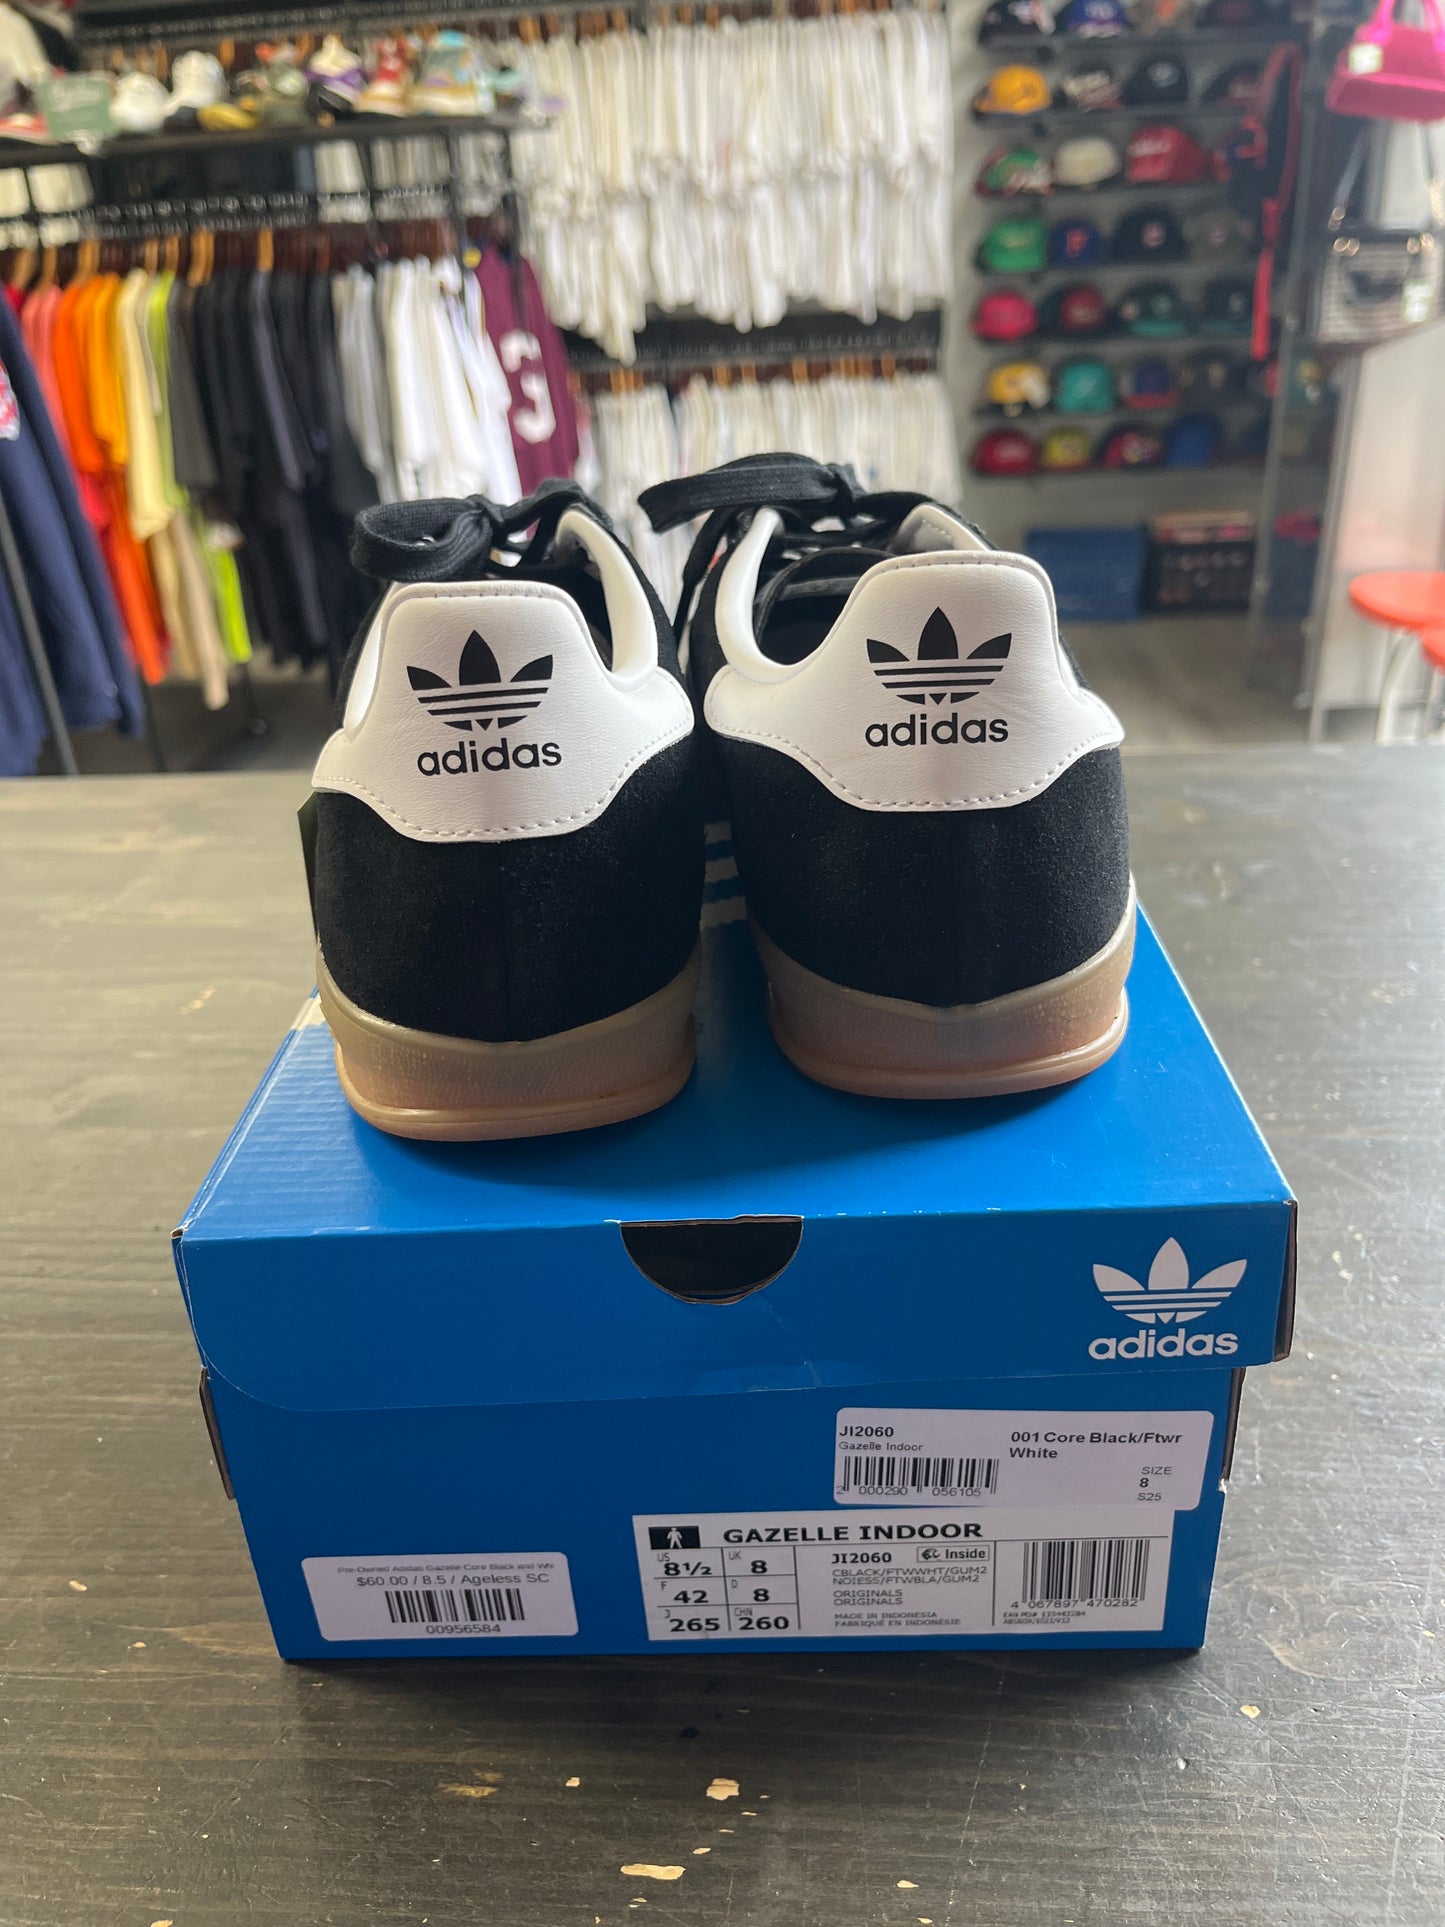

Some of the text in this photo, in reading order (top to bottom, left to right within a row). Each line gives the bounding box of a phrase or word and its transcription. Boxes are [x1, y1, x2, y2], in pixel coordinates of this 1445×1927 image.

[865, 711, 1010, 748] adidas
[417, 738, 562, 777] adidas
[1088, 1327, 1239, 1360] adidas
[838, 1425, 895, 1438] JI2060
[1010, 1431, 1183, 1444] 001 Core Black/Ftwr
[838, 1441, 924, 1452] Gazelle Indoor
[1009, 1447, 1058, 1459] White
[1141, 1466, 1173, 1475] SIZE
[1139, 1477, 1150, 1488] 8
[858, 1485, 909, 1496] 000290
[931, 1486, 982, 1497] 056105
[1137, 1492, 1163, 1502] S25
[723, 1523, 984, 1544] GAZELLE INDOOR
[657, 1552, 670, 1562] US
[728, 1551, 742, 1561] UK
[831, 1551, 893, 1564] JI2060
[945, 1548, 986, 1559] Inside
[750, 1559, 768, 1574] 8
[356, 1575, 409, 1587] $60.00
[422, 1574, 447, 1585] 8.5
[461, 1573, 522, 1587] Ageless
[526, 1572, 550, 1583] SC
[731, 1579, 739, 1589] D
[660, 1581, 668, 1591] F
[673, 1589, 709, 1604] 42
[752, 1587, 770, 1602] 8
[832, 1588, 903, 1598] ORIGINALS
[833, 1597, 903, 1606] ORIGINALS
[1010, 1598, 1138, 1609] 4 067897 470282
[669, 1617, 721, 1633] 265
[738, 1615, 790, 1631] 260
[425, 1624, 502, 1635] 00956584
